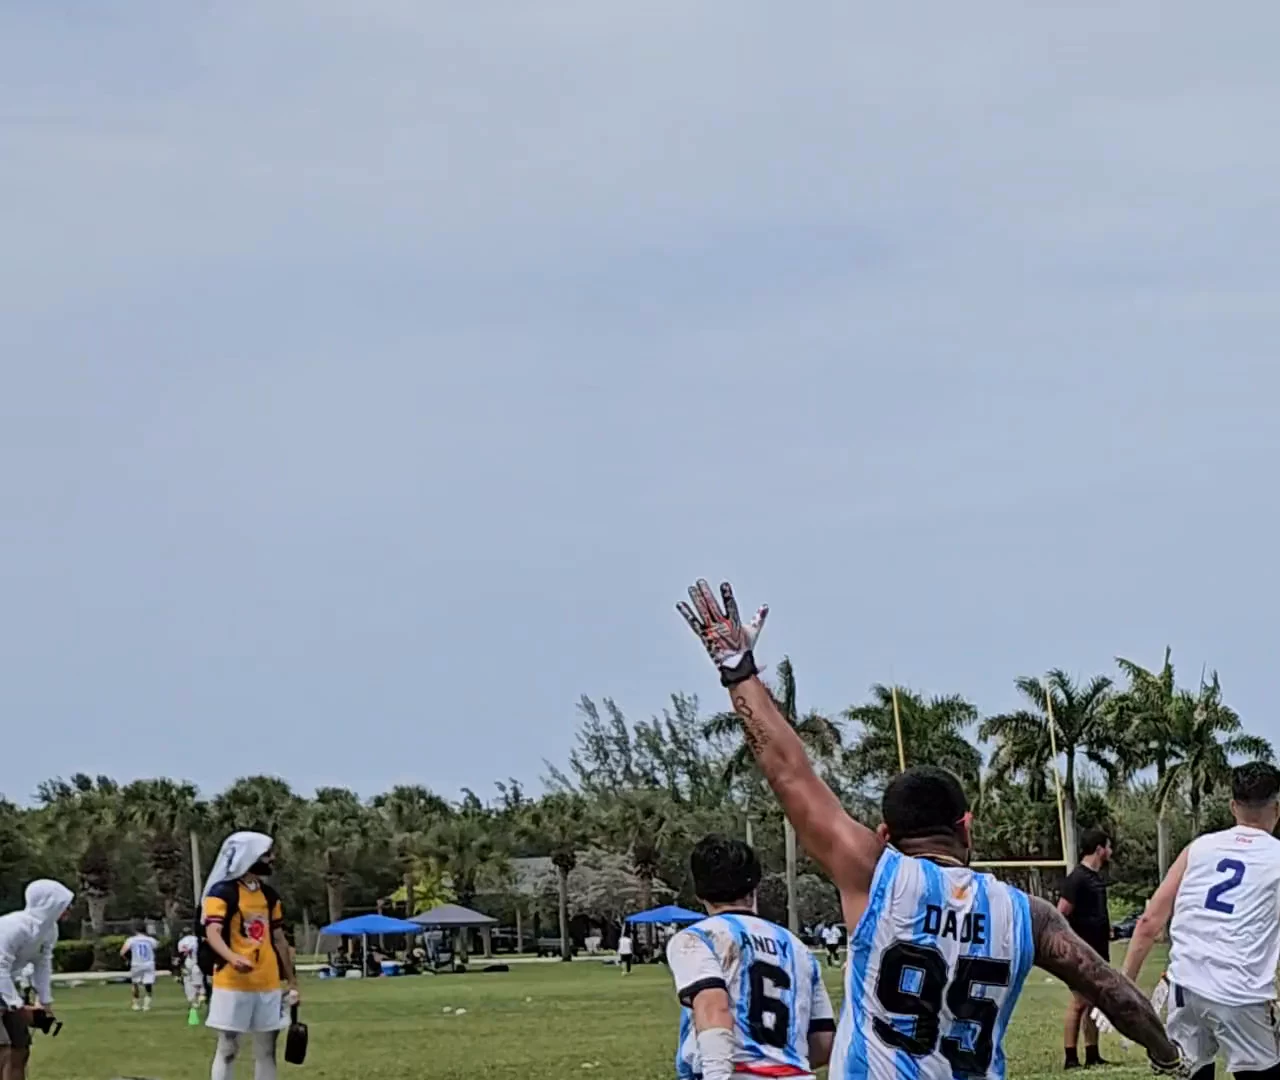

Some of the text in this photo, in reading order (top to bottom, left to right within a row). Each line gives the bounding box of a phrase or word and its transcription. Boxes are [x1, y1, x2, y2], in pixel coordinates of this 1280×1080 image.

[1204, 858, 1246, 915] 2
[738, 931, 788, 958] ANDY
[748, 960, 792, 1050] 6
[872, 941, 1011, 1077] 95
